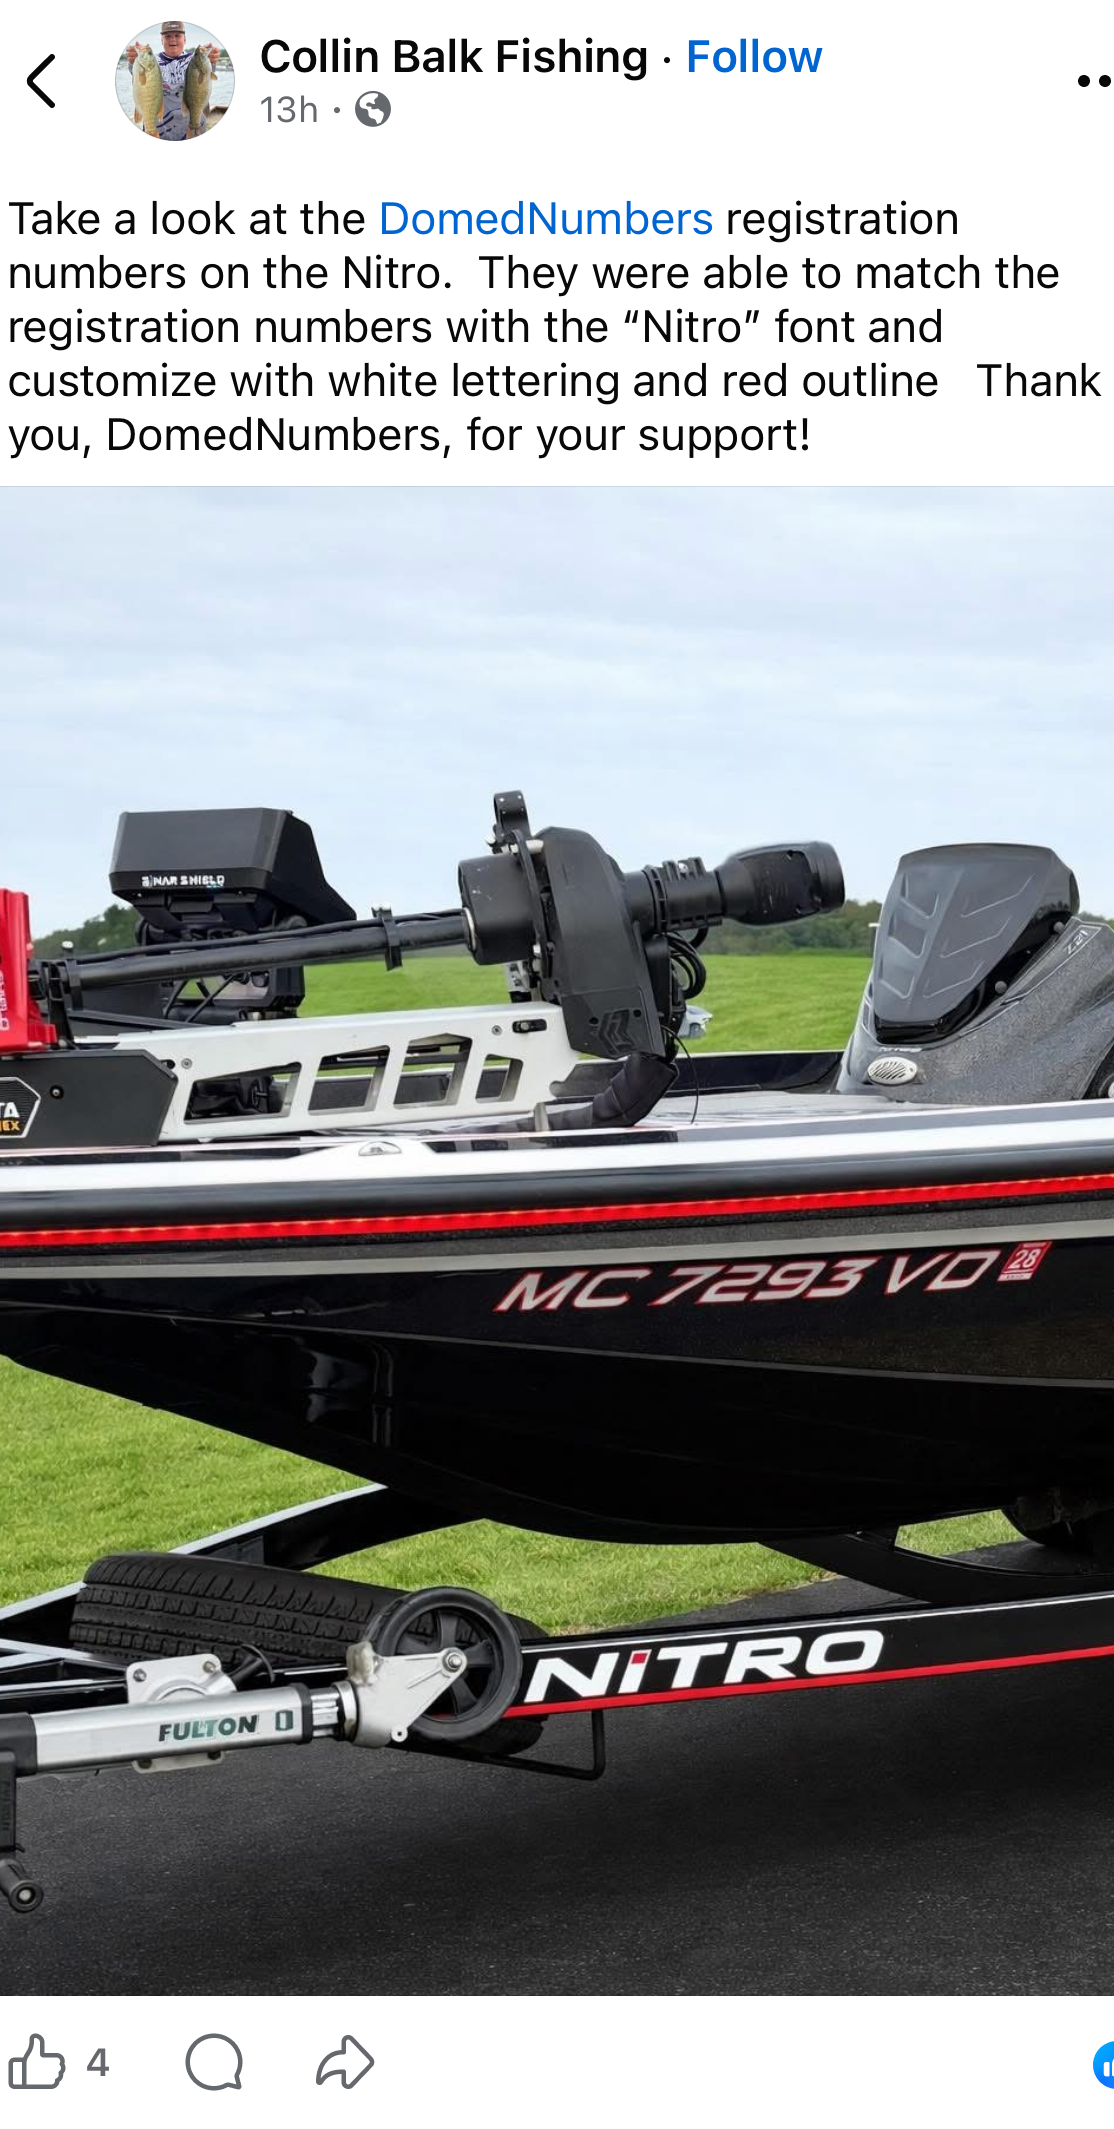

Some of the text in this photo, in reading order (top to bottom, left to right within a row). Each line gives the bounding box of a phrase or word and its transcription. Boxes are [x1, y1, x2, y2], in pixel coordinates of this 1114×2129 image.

[1007, 1248, 1042, 1270] 28
[493, 1249, 1002, 1312] MC 7293 VD
[158, 1704, 259, 1742] FULTON
